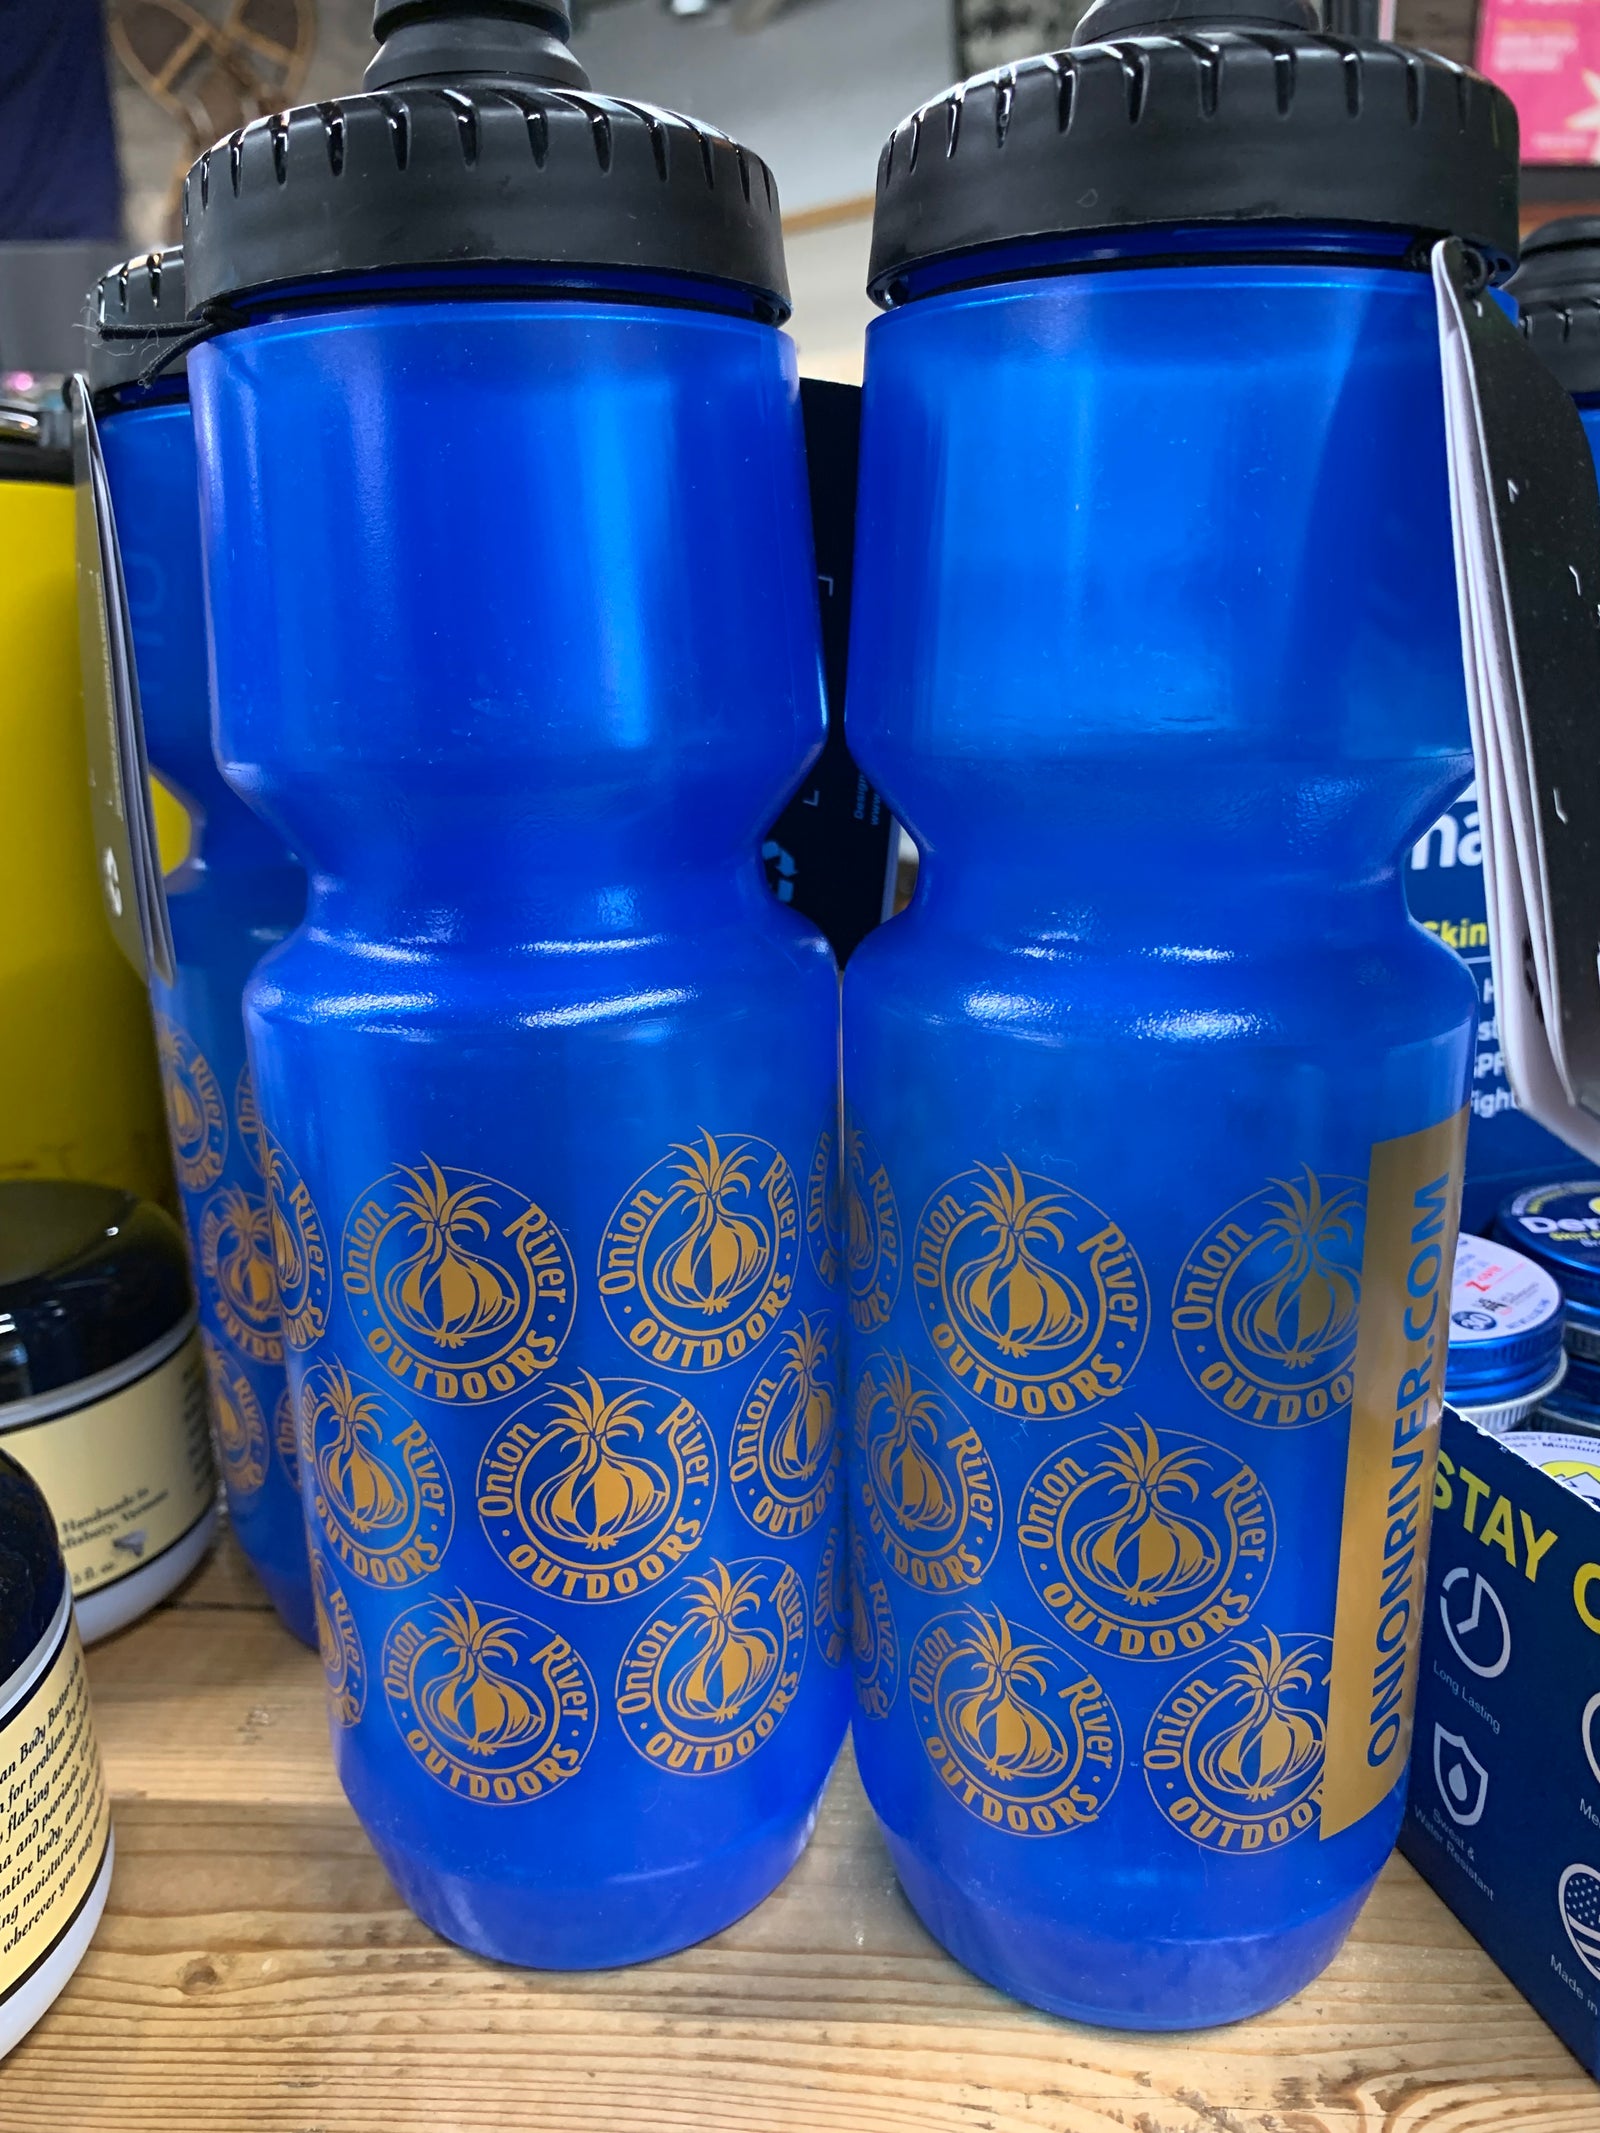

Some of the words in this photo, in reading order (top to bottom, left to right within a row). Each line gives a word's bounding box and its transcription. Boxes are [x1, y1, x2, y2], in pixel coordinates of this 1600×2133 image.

[289, 1182, 326, 1281] River
[342, 1200, 390, 1295] Onion
[503, 1202, 566, 1304] River
[599, 1189, 663, 1295] Onion
[759, 1152, 796, 1241] River
[869, 1163, 898, 1268] River
[913, 1194, 966, 1288] Onion
[1077, 1220, 1139, 1332] River
[630, 1272, 792, 1367] OUTDOORS
[1172, 1223, 1253, 1331] Onion
[216, 1301, 283, 1360] OUTDO
[367, 1328, 558, 1400] OUTDOORS
[932, 1323, 1123, 1415] OUTDOORS
[730, 1377, 777, 1482] Onion
[1200, 1362, 1353, 1424] OUTDOO
[392, 1420, 445, 1517] River
[478, 1423, 541, 1516] Onion
[656, 1397, 709, 1486] River
[947, 1426, 994, 1531] River
[1368, 1173, 1449, 1768] ONIONRIVER.COM
[316, 1495, 440, 1583] OUTDOORS
[862, 1483, 982, 1589] OUTDOORS
[1018, 1457, 1089, 1549] Onion
[1211, 1464, 1266, 1562] River
[1434, 1449, 1558, 1583] STAY
[508, 1516, 702, 1600] OUTDOORS
[330, 1587, 361, 1678] River
[617, 1619, 677, 1714] Onion
[768, 1564, 804, 1641] River
[869, 1578, 895, 1674] River
[1043, 1582, 1249, 1656] OUTDOORS
[384, 1621, 426, 1699] Onion
[529, 1634, 588, 1721] River
[909, 1626, 957, 1704] Onion
[1058, 1673, 1113, 1769] River
[1433, 1659, 1460, 1696] Long
[1462, 1686, 1501, 1735] Lasting
[20, 1725, 46, 1764] Body
[48, 1684, 70, 1729] Butter
[407, 1729, 581, 1800] OUTDOORS
[646, 1671, 799, 1771] OUTDOORS
[1144, 1679, 1218, 1770] Onion
[6, 1781, 50, 1842] flaking
[7, 1780, 26, 1813] for
[29, 1727, 65, 1789] problem
[926, 1736, 1099, 1831] OUTDOORS
[1579, 1797, 1600, 1828] Me
[16, 1818, 39, 1857] and
[37, 1824, 63, 1863] body,
[1169, 1788, 1320, 1849] OUTDOO
[1414, 1804, 1444, 1843] Water
[1446, 1840, 1495, 1901] Resistant
[1433, 1808, 1465, 1851] Sweat
[1467, 1846, 1476, 1862] &
[4, 1889, 57, 1954] wherever
[59, 1862, 77, 1897] you
[1550, 1953, 1584, 2000] Made
[1587, 1994, 1599, 2016] in
